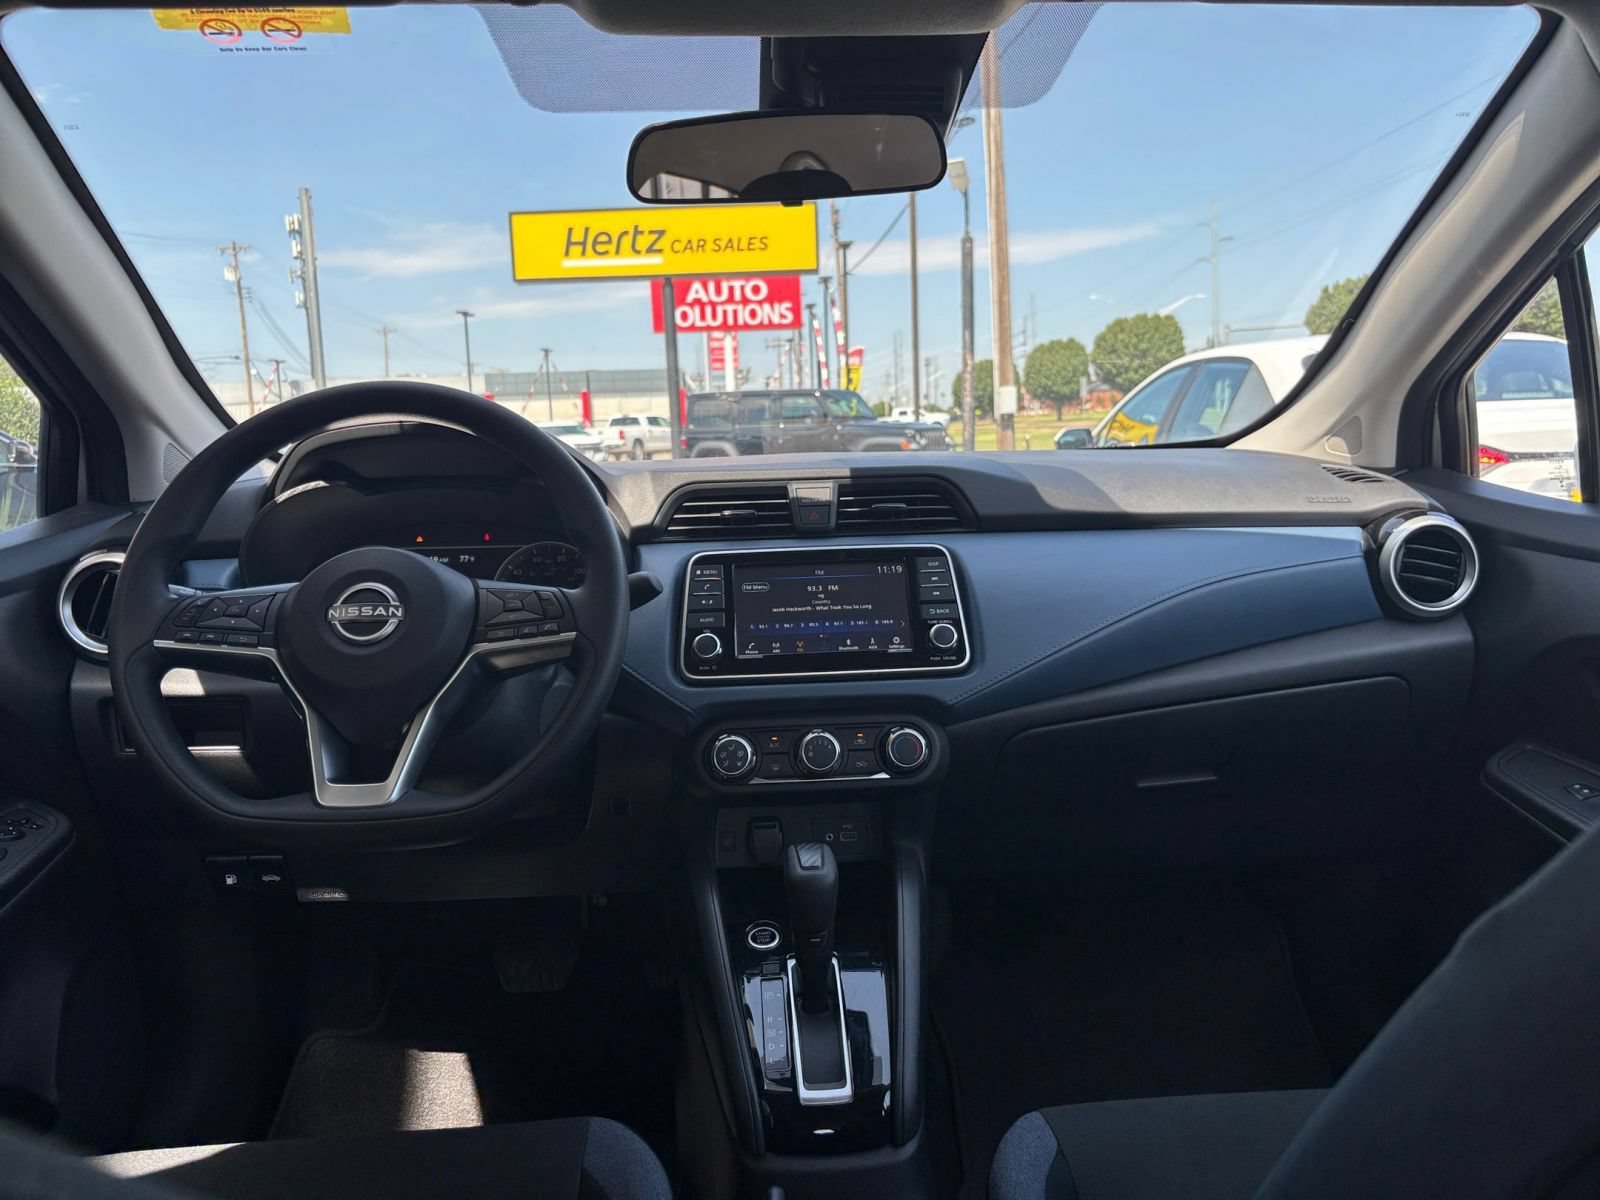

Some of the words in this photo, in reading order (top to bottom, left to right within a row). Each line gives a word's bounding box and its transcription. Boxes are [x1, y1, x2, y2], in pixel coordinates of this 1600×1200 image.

[564, 225, 666, 257] Hertz
[670, 238, 706, 254] CAR
[711, 236, 769, 252] SALES
[685, 279, 768, 304] AUTO
[674, 303, 794, 328] OLUTIONS
[876, 565, 903, 574] 11:19
[328, 606, 405, 619] NISSAN
